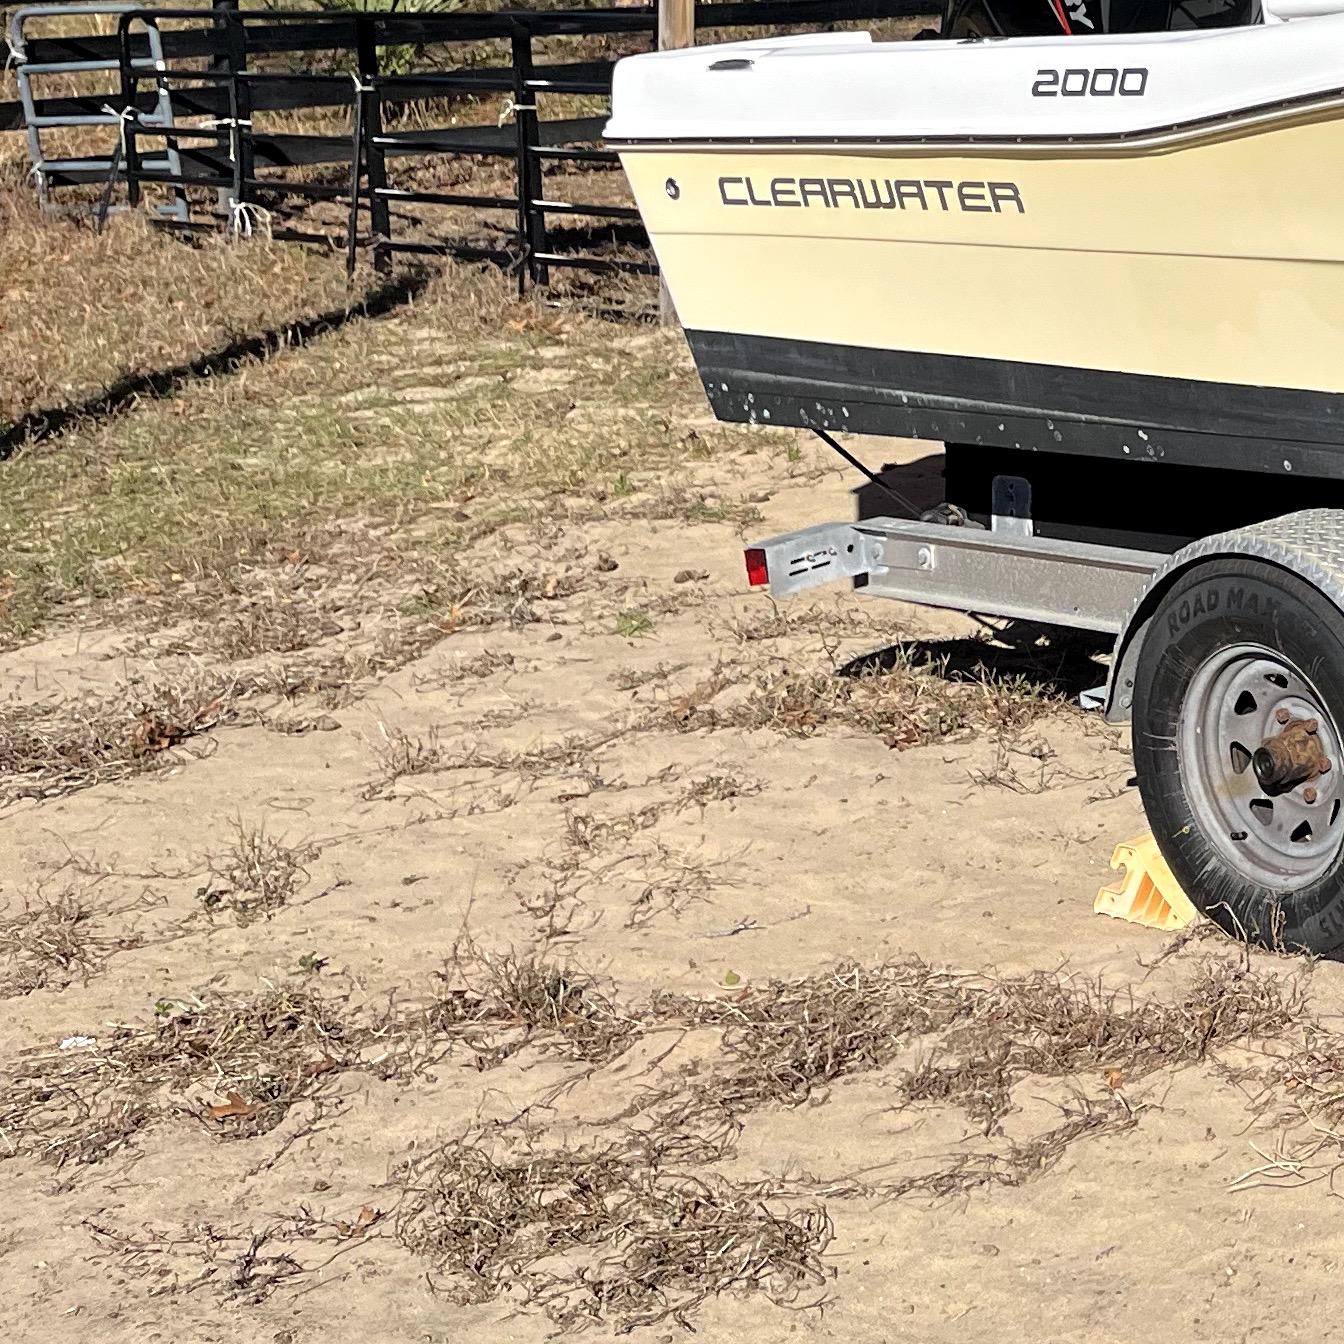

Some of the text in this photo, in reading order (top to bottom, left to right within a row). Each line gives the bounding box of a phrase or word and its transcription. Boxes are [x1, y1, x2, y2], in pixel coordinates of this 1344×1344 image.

[1031, 67, 1149, 98] 2000
[718, 175, 1025, 214] CLEARWATER
[1167, 588, 1220, 638] ROAD
